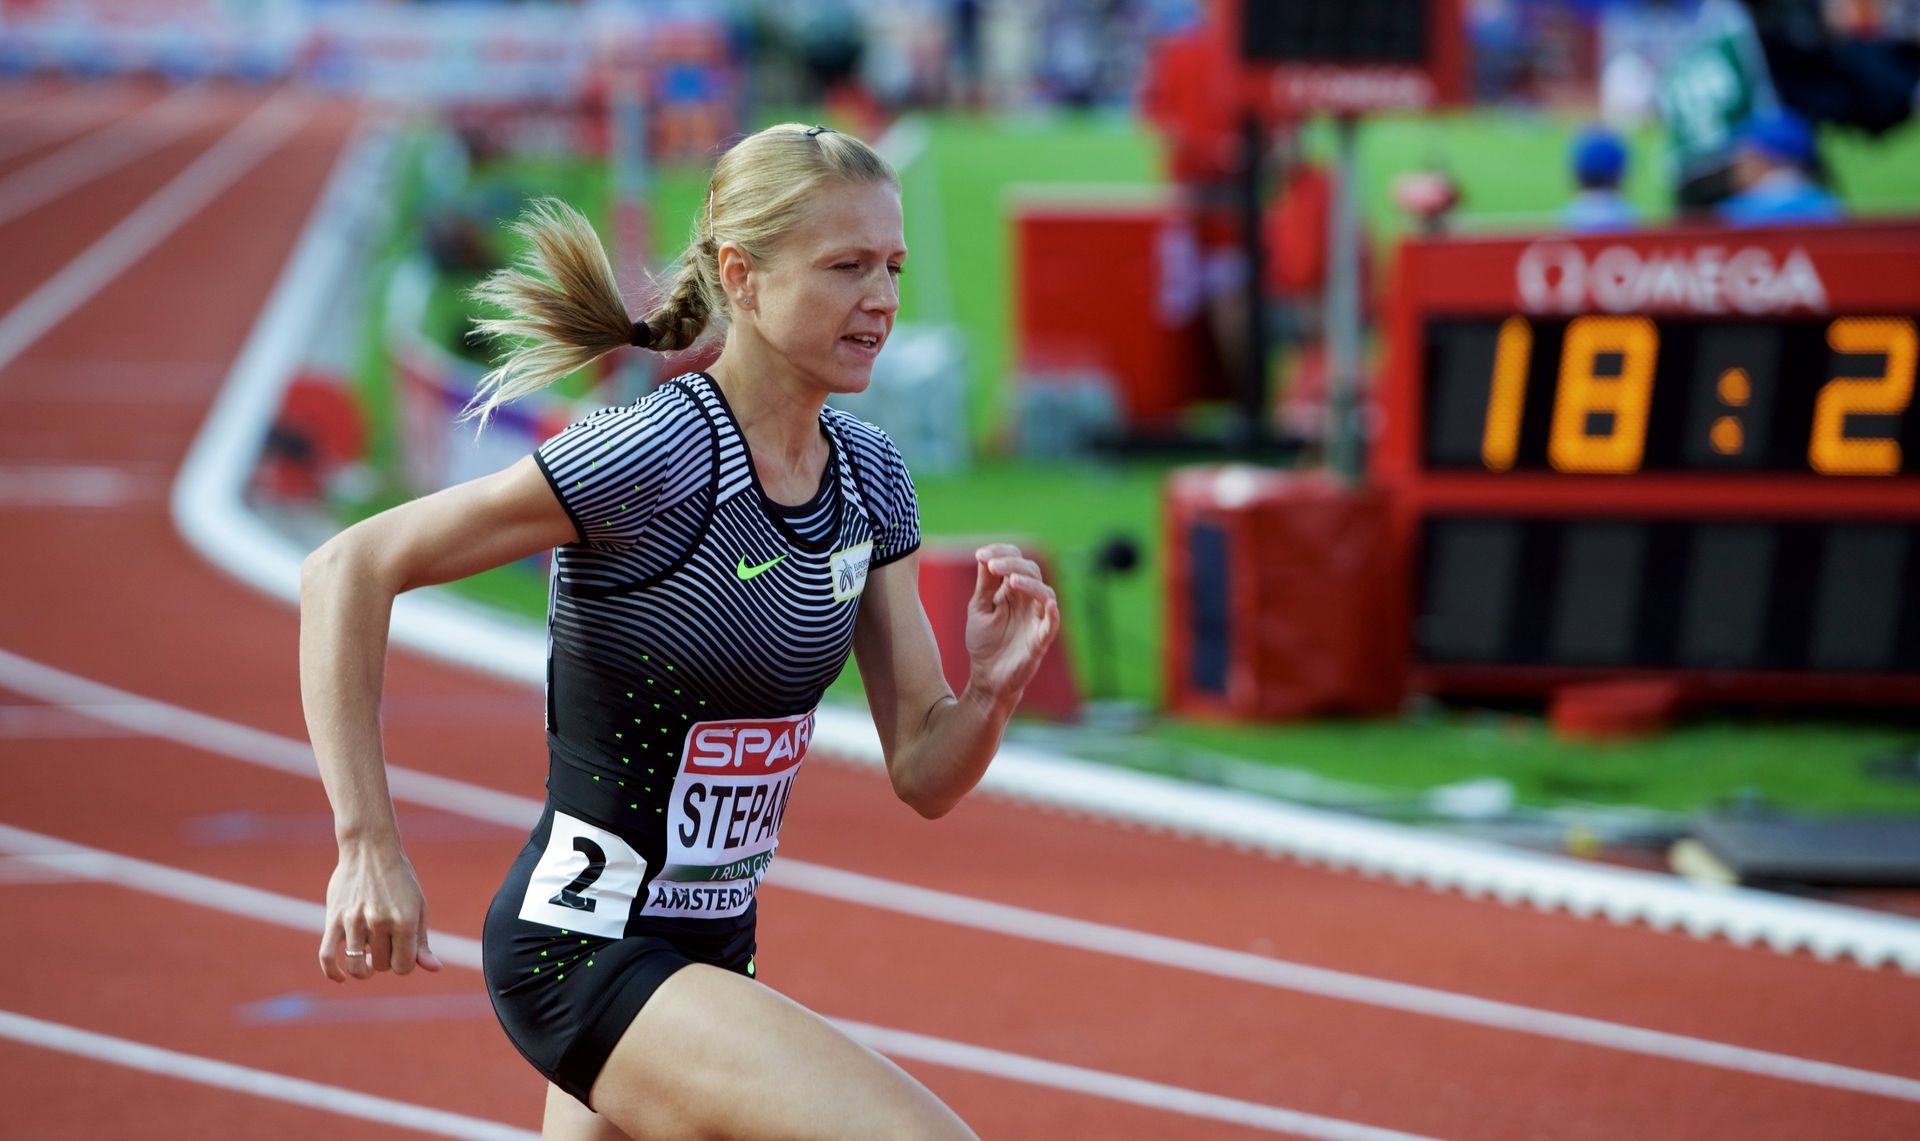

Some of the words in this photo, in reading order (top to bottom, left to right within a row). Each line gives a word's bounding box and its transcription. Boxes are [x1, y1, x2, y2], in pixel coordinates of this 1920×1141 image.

[1591, 245, 1829, 313] OMEGA
[548, 836, 607, 913] 2
[719, 859, 750, 880] RUN
